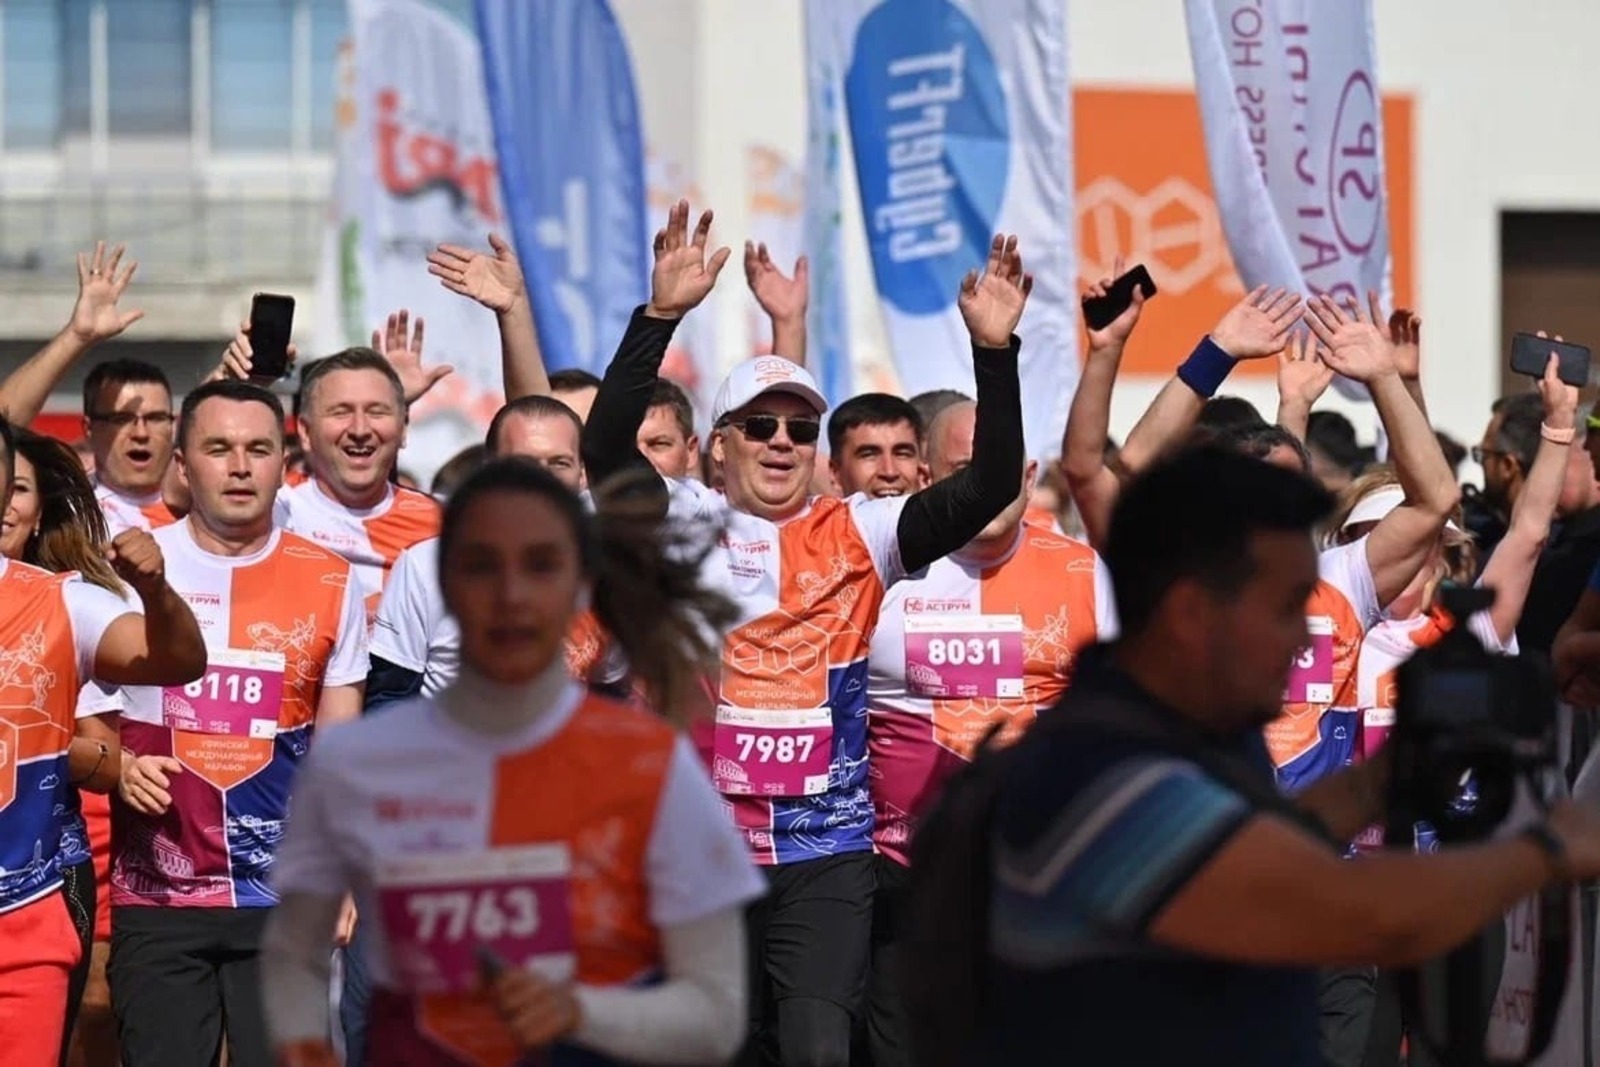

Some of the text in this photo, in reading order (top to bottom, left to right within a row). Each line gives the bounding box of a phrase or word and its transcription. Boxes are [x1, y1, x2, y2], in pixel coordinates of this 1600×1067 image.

[925, 602, 971, 612] АСТРУМ
[928, 637, 1001, 666] 8031
[184, 672, 263, 704] 8118
[254, 724, 261, 734] 2
[185, 749, 263, 761] МЕЖДУНАРОДНЫЙ
[735, 732, 815, 764] 7987
[407, 887, 539, 941] 7763
